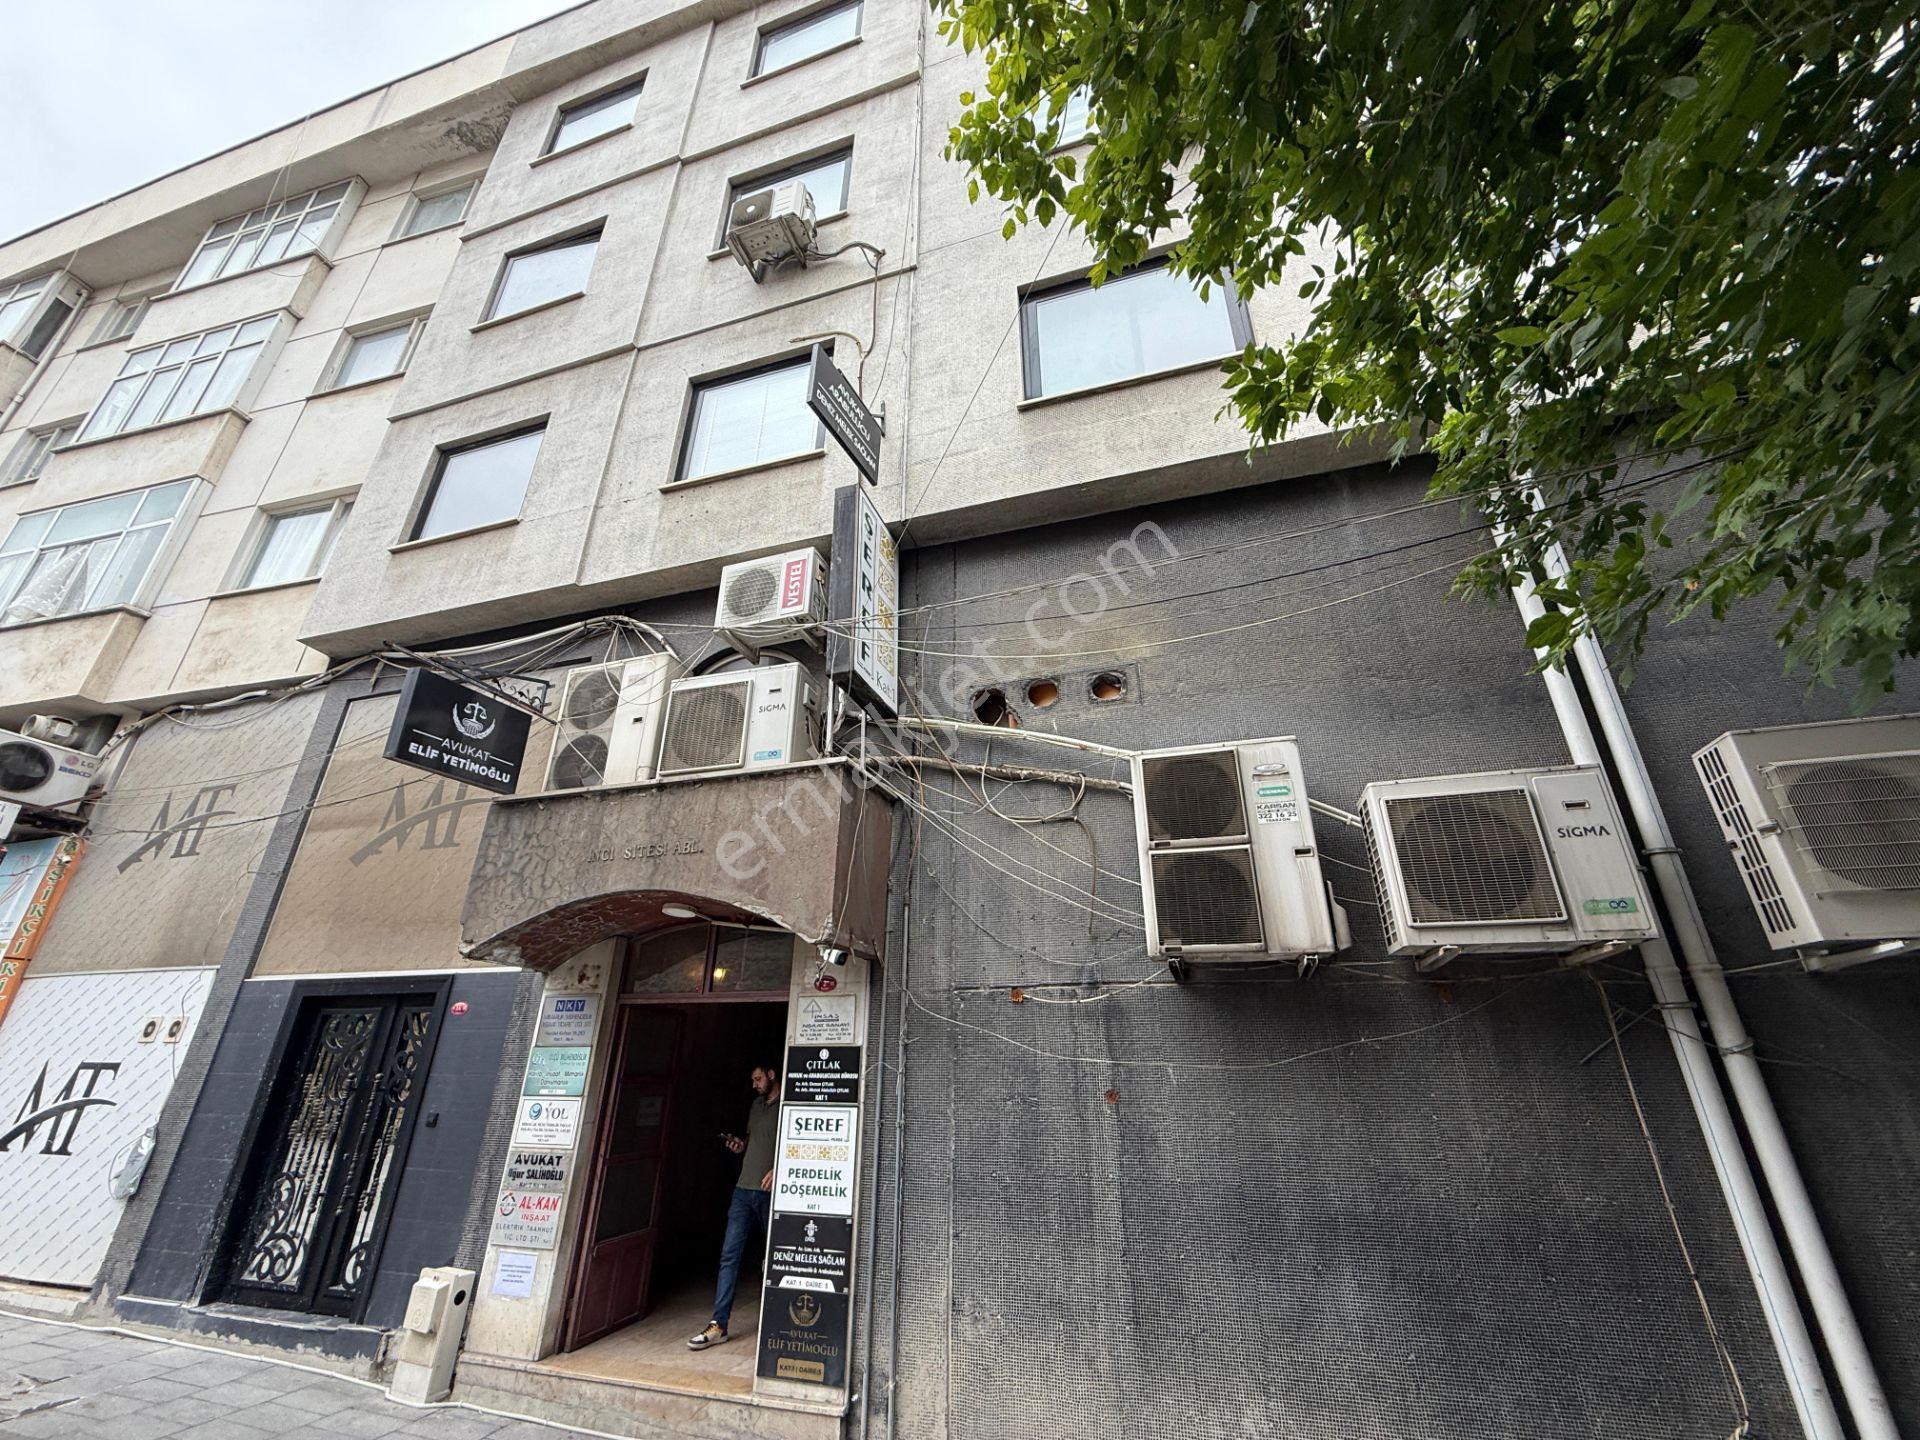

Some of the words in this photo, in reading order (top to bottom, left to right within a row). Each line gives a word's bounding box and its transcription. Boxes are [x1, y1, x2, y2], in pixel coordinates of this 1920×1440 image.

[837, 384, 865, 420] AVUKAT
[828, 384, 871, 441] ARABULUCU
[786, 559, 803, 607] VESTEL
[441, 738, 490, 762] AVUKAT
[80, 761, 95, 769] LG
[408, 742, 440, 760] ELİF
[442, 752, 511, 783] YETİMOĞLU
[58, 766, 92, 778] BEKO
[555, 1000, 585, 1012] NKY
[806, 1060, 841, 1071] ÇITLAK
[794, 1117, 845, 1136] ŞEREF
[514, 1154, 563, 1167] AVUKAT
[508, 1168, 525, 1181] Uğur
[526, 1167, 565, 1181] SALİHOĞLU
[787, 1167, 842, 1181] PERDELİK
[781, 1181, 848, 1198] DÖŞEMELİK
[519, 1195, 562, 1211] AL-KAN
[773, 1250, 795, 1262] DENİZ
[795, 1253, 818, 1264] MELEK
[818, 1254, 846, 1266] SAĞLAM
[790, 1330, 818, 1340] AVUKAT
[767, 1338, 785, 1350] ELİF
[786, 1341, 839, 1357] YETİMOĞLU
